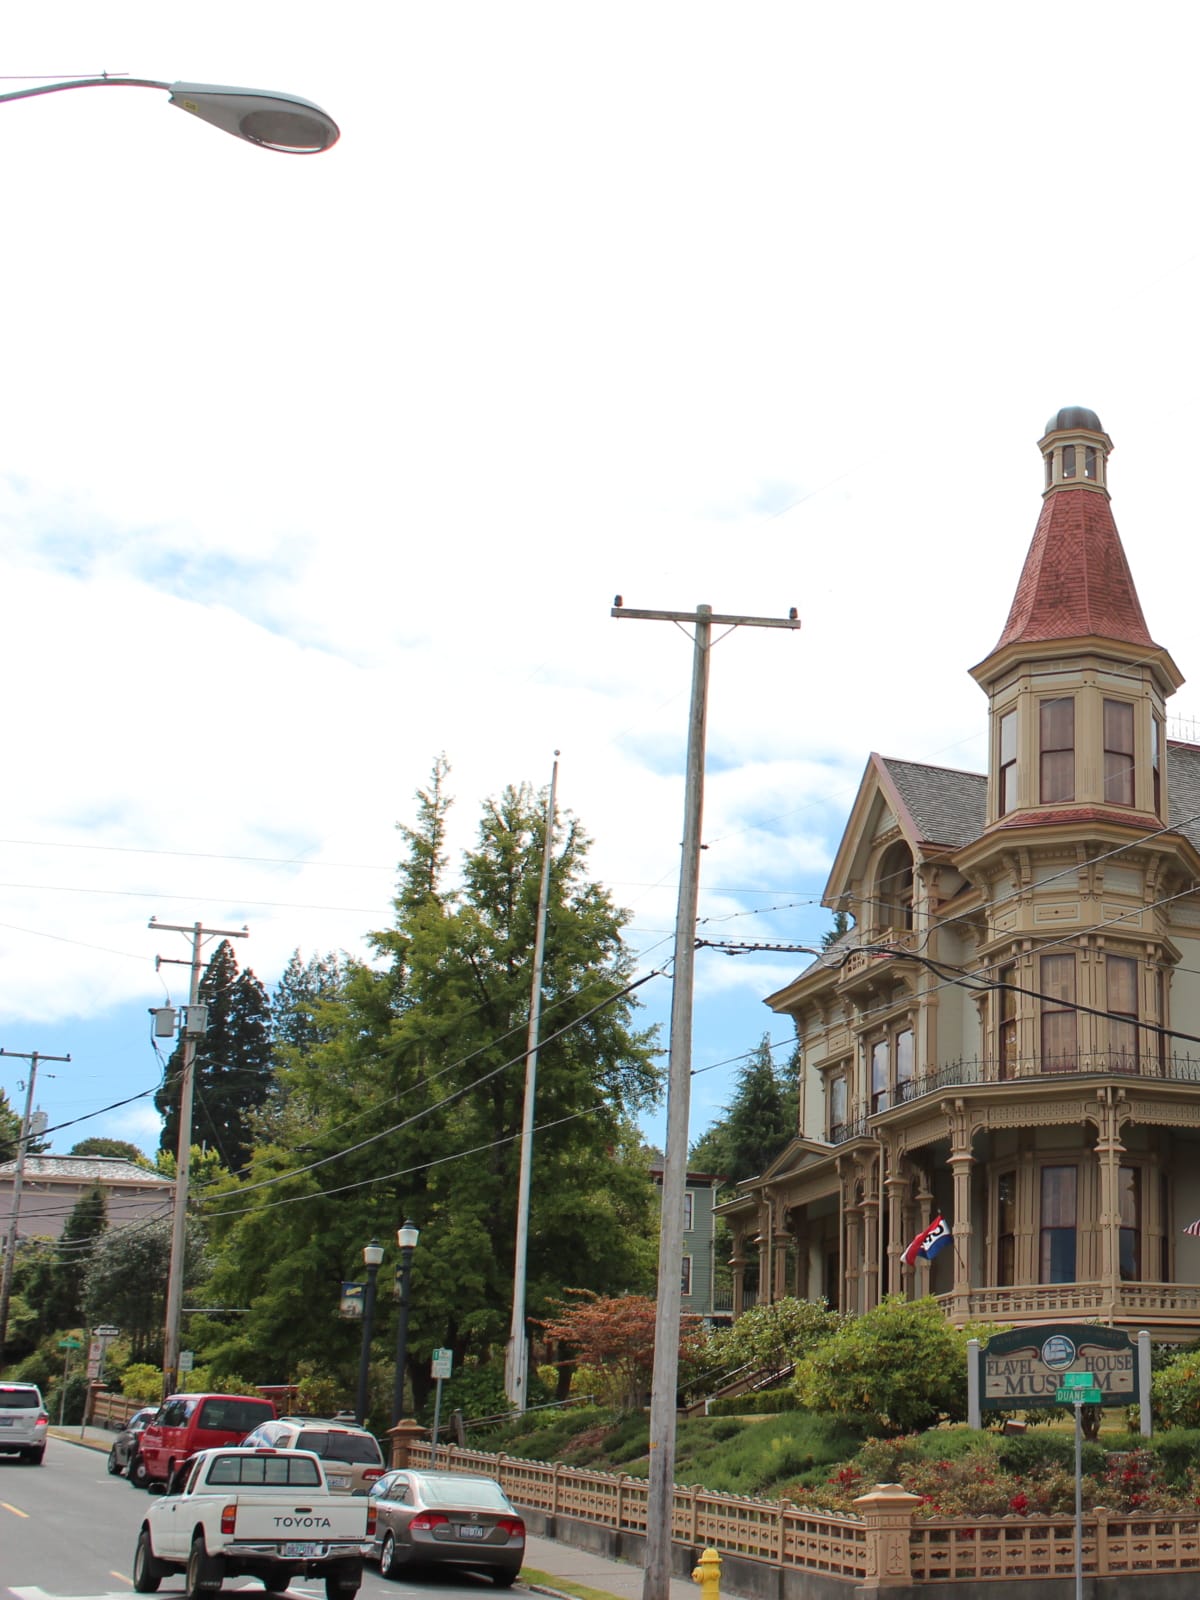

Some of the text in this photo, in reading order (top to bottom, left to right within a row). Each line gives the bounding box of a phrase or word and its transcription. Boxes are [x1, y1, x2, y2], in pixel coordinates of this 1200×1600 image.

[988, 1354, 1133, 1376] FLAVEL HOUSE
[1005, 1372, 1112, 1395] MUSM
[1057, 1391, 1086, 1401] DUANE
[273, 1517, 331, 1528] TOYOTA
